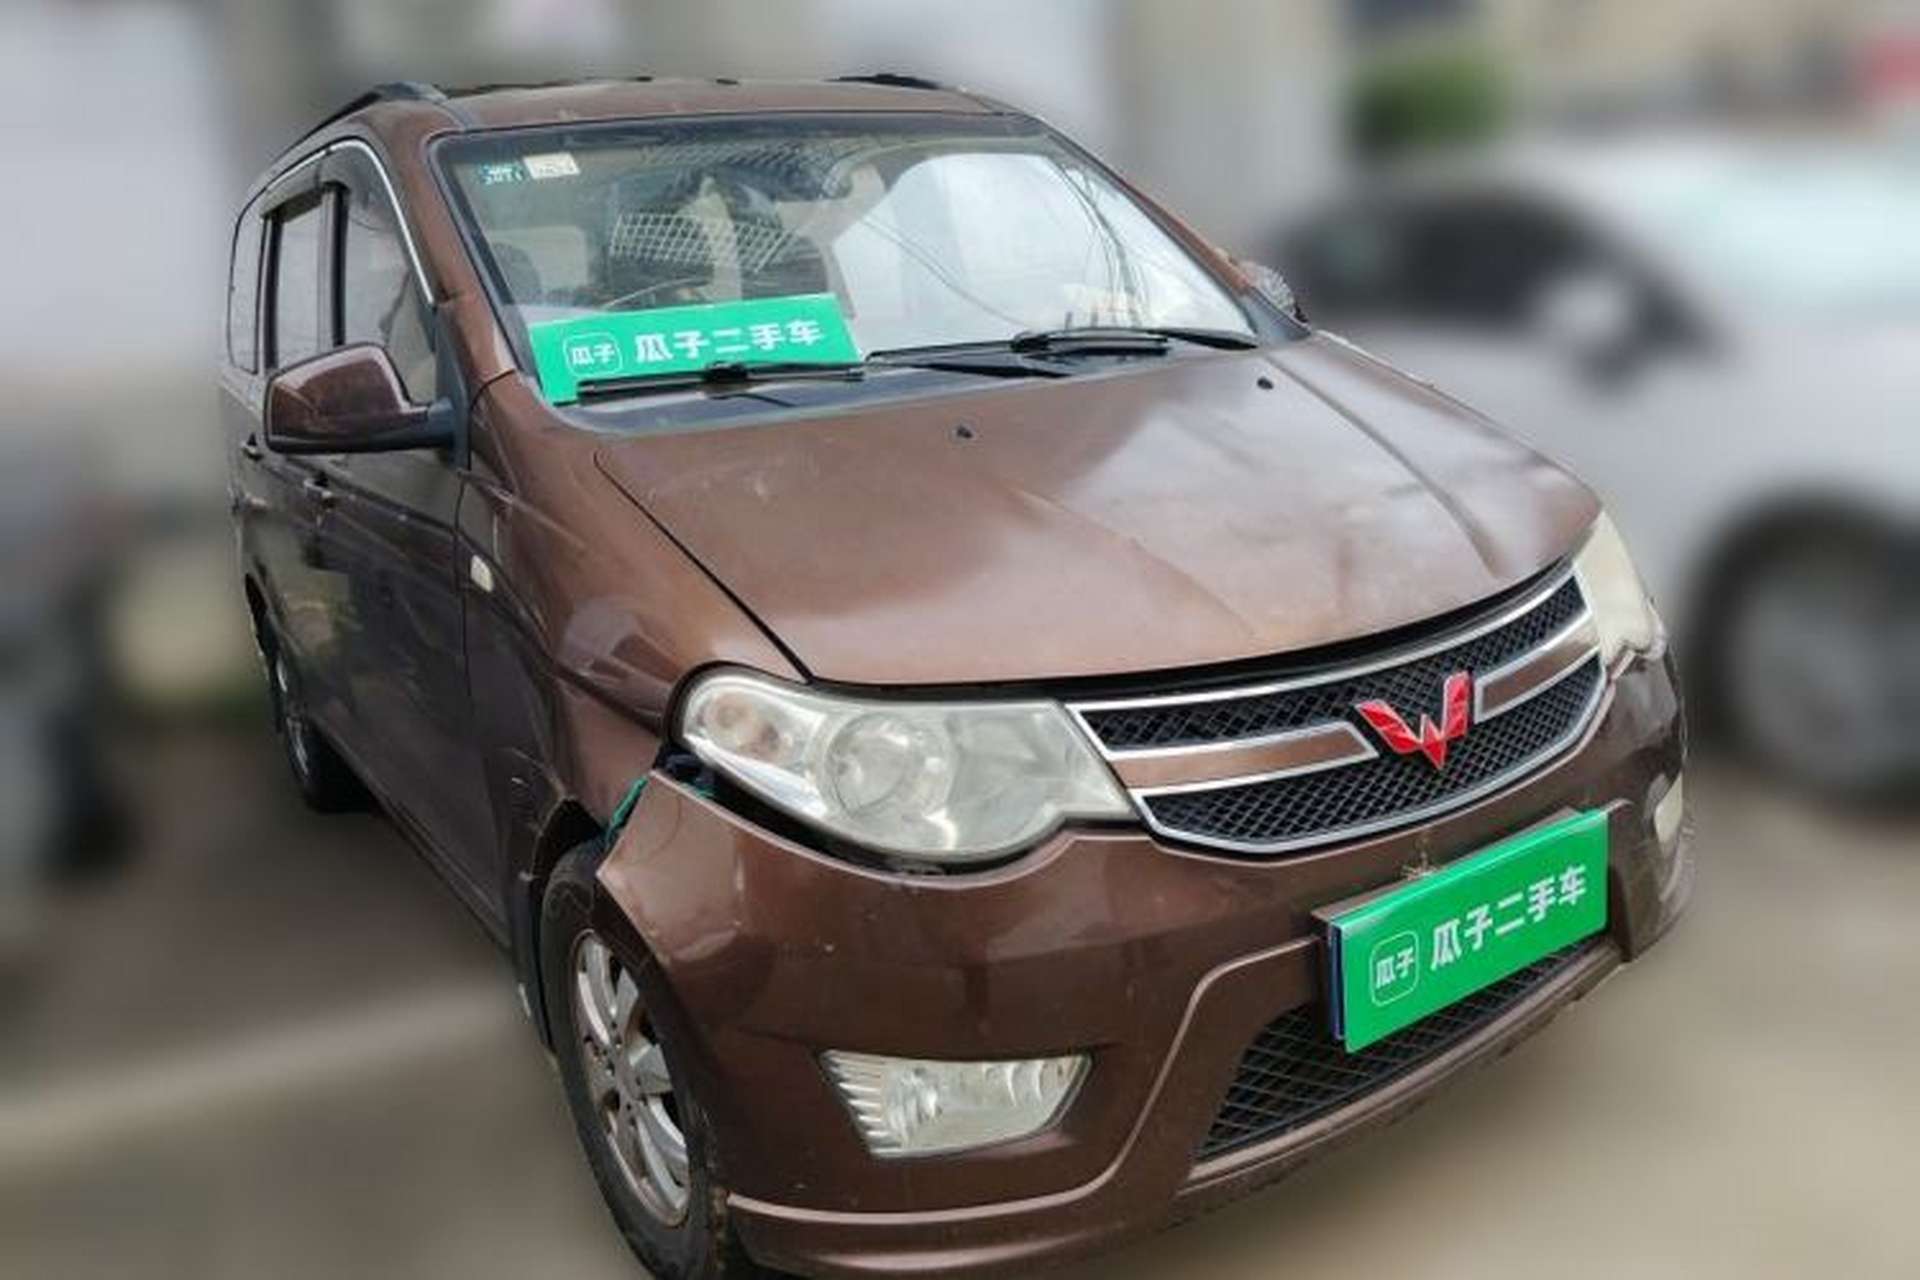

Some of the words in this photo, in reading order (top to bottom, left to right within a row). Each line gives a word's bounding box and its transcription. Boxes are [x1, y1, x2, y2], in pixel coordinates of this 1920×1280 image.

[570, 342, 616, 366] 瓜子
[635, 319, 823, 362] 瓜子二手车
[1430, 865, 1586, 971] 瓜子二手车
[1375, 947, 1415, 989] 瓜子
